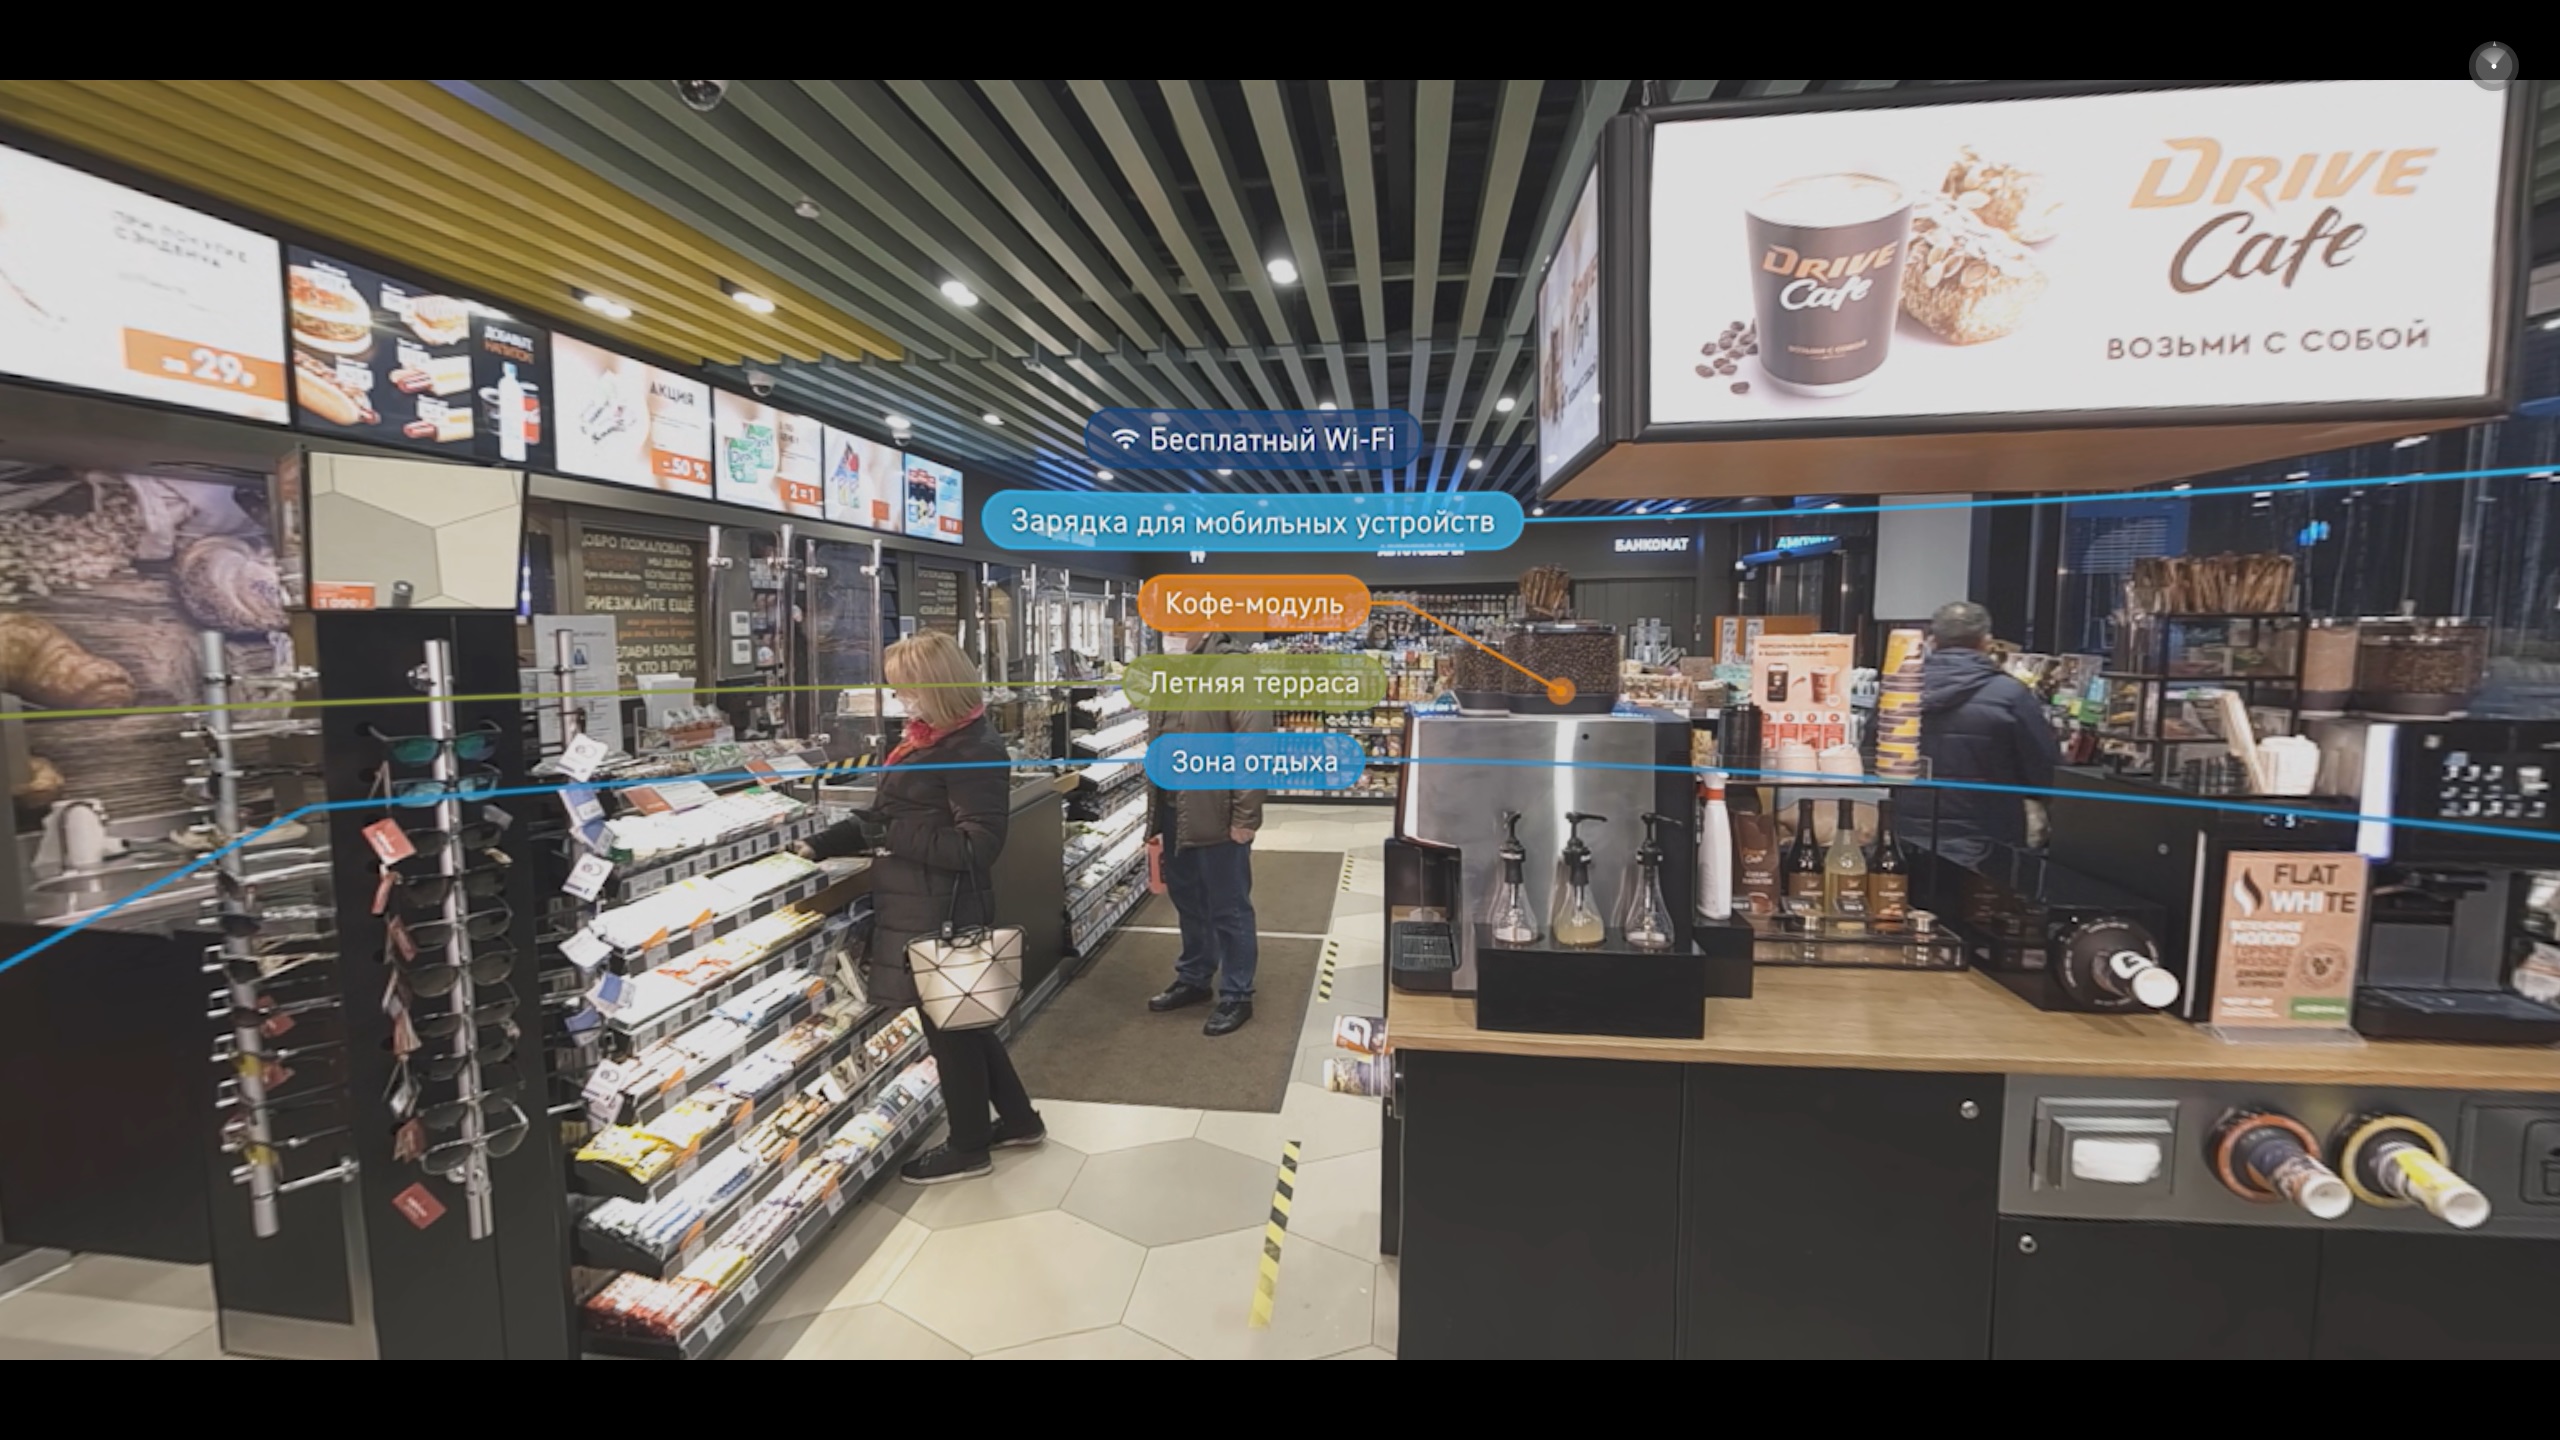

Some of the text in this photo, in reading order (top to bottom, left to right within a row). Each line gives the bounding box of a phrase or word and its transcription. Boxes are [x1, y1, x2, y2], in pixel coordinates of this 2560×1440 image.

[2130, 136, 2438, 211] DRIVE
[1761, 240, 1899, 283] DRIVE
[2168, 205, 2368, 294] Cafe
[1780, 274, 1875, 311] Cafe
[2107, 319, 2430, 360] ВОЗЬМИ С СОБОЙ
[650, 380, 695, 407] АКЦИЯ
[1614, 537, 1689, 552] БАНКОМАТ
[2273, 863, 2340, 885] FLAT
[2269, 890, 2357, 914] WHITE
